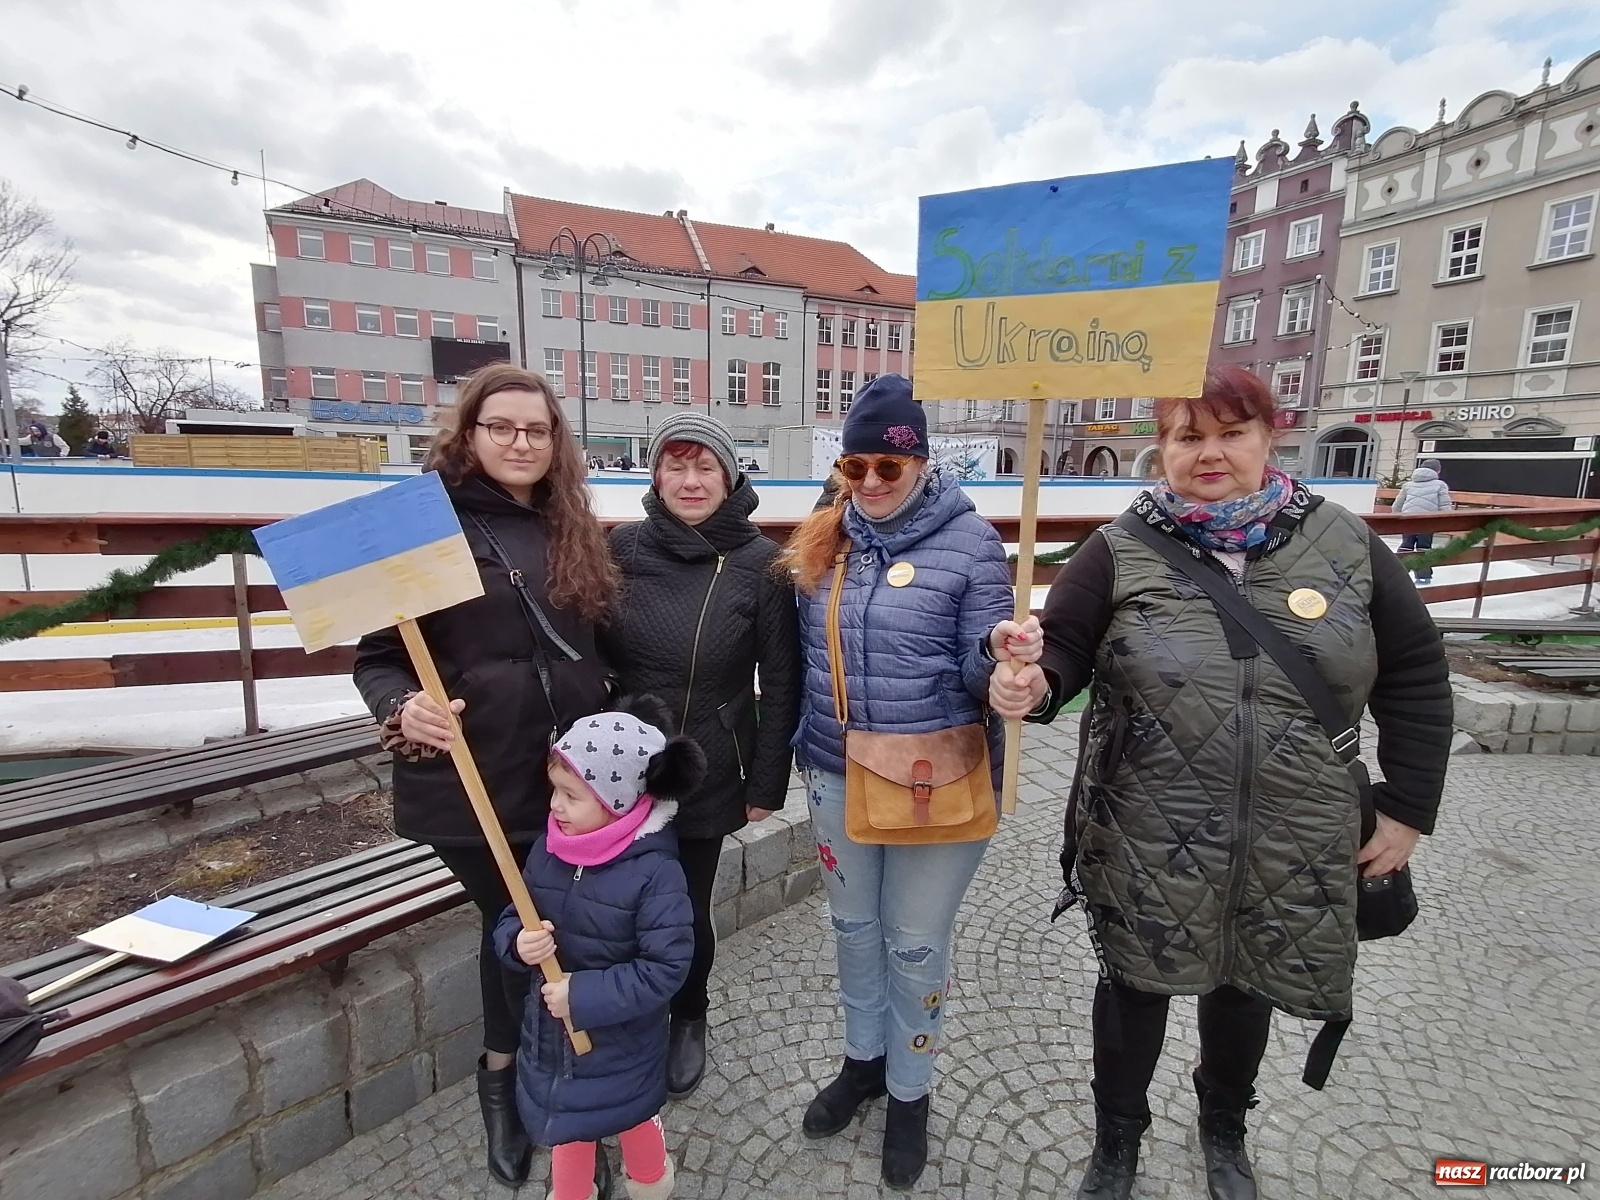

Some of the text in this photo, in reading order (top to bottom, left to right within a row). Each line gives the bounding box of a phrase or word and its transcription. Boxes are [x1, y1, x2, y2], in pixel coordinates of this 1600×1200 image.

[926, 227, 1145, 301] Solidarni
[953, 301, 1153, 374] Ukrainą
[1457, 405, 1515, 421] SHIRO
